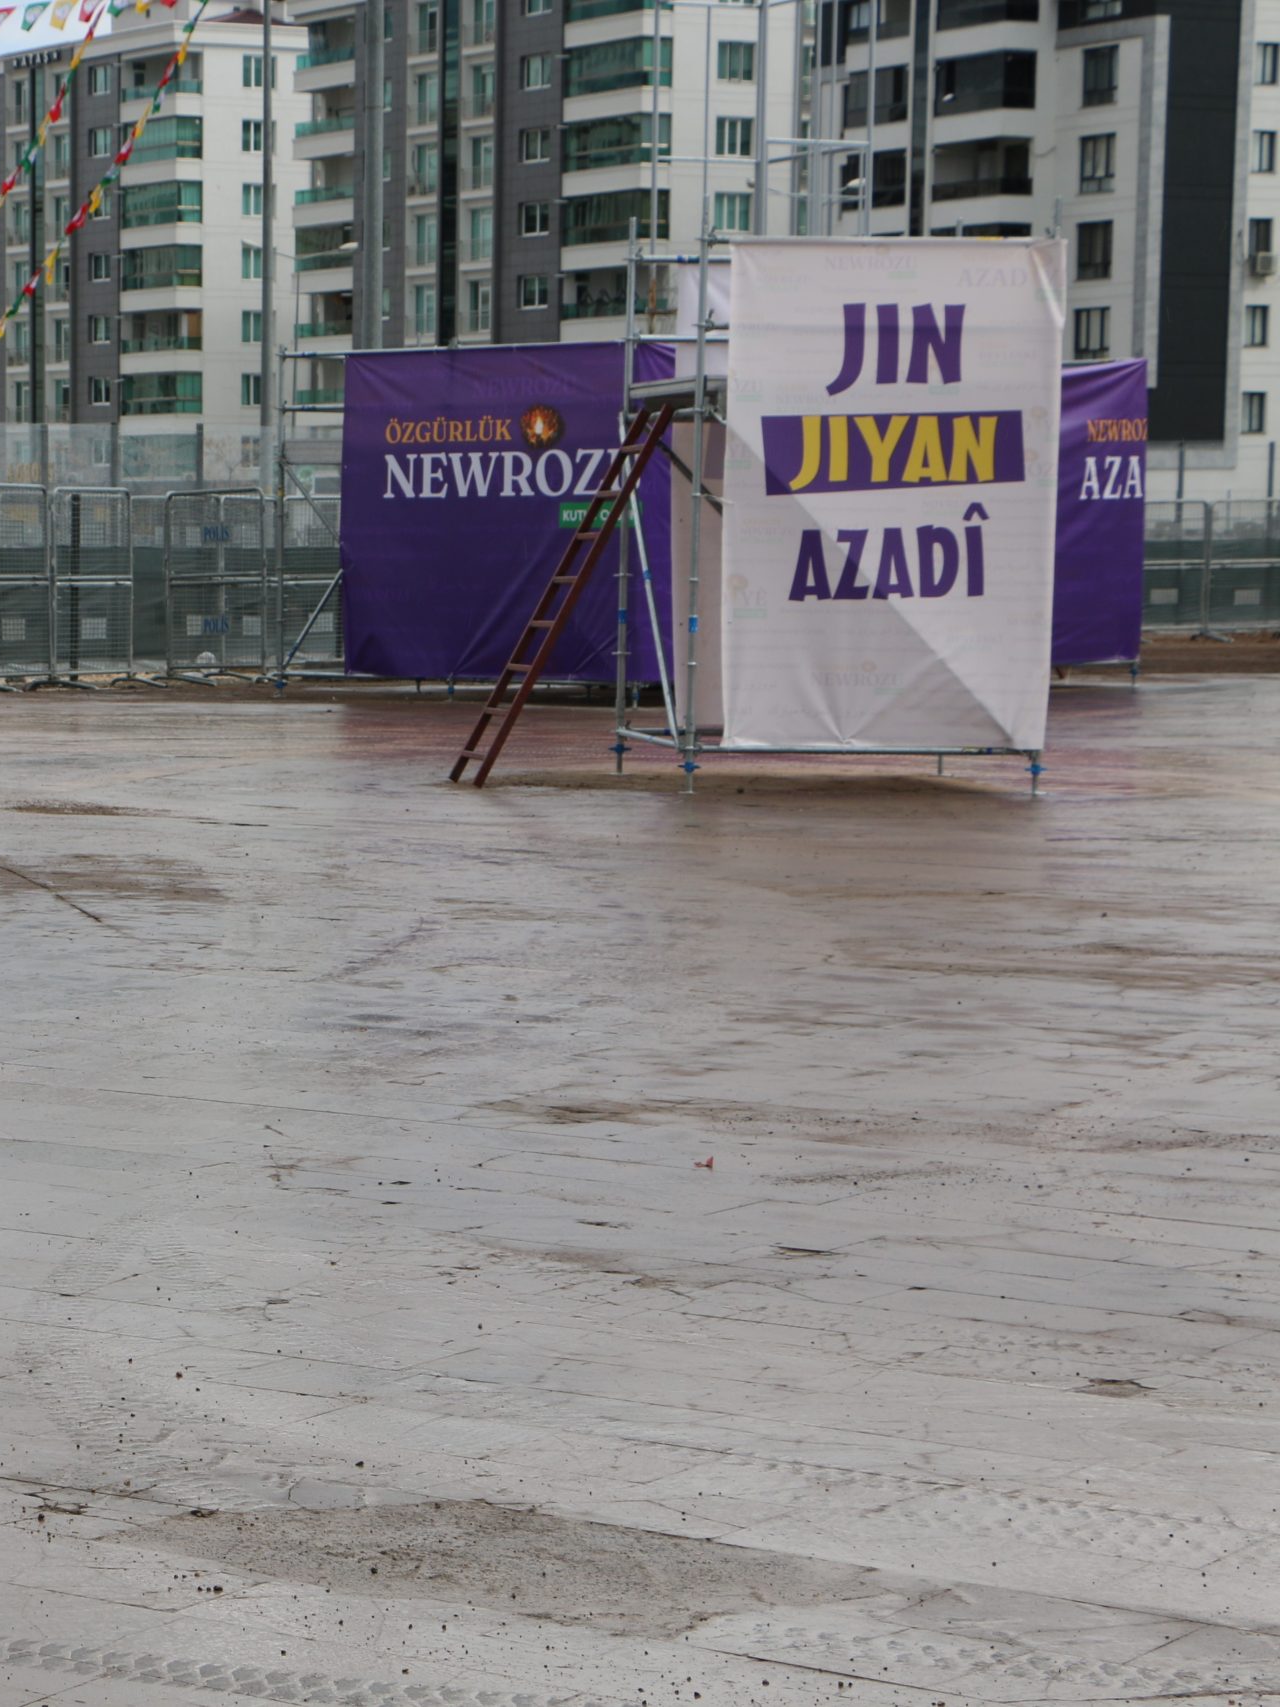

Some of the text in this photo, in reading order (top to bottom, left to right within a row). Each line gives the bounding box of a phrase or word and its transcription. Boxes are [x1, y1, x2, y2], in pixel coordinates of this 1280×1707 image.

[826, 303, 966, 396] JIN
[385, 416, 512, 444] ÖZGÜRLÜK
[789, 415, 998, 491] JIYAN
[1079, 455, 1143, 500] AZA
[788, 502, 990, 601] AZADÎ
